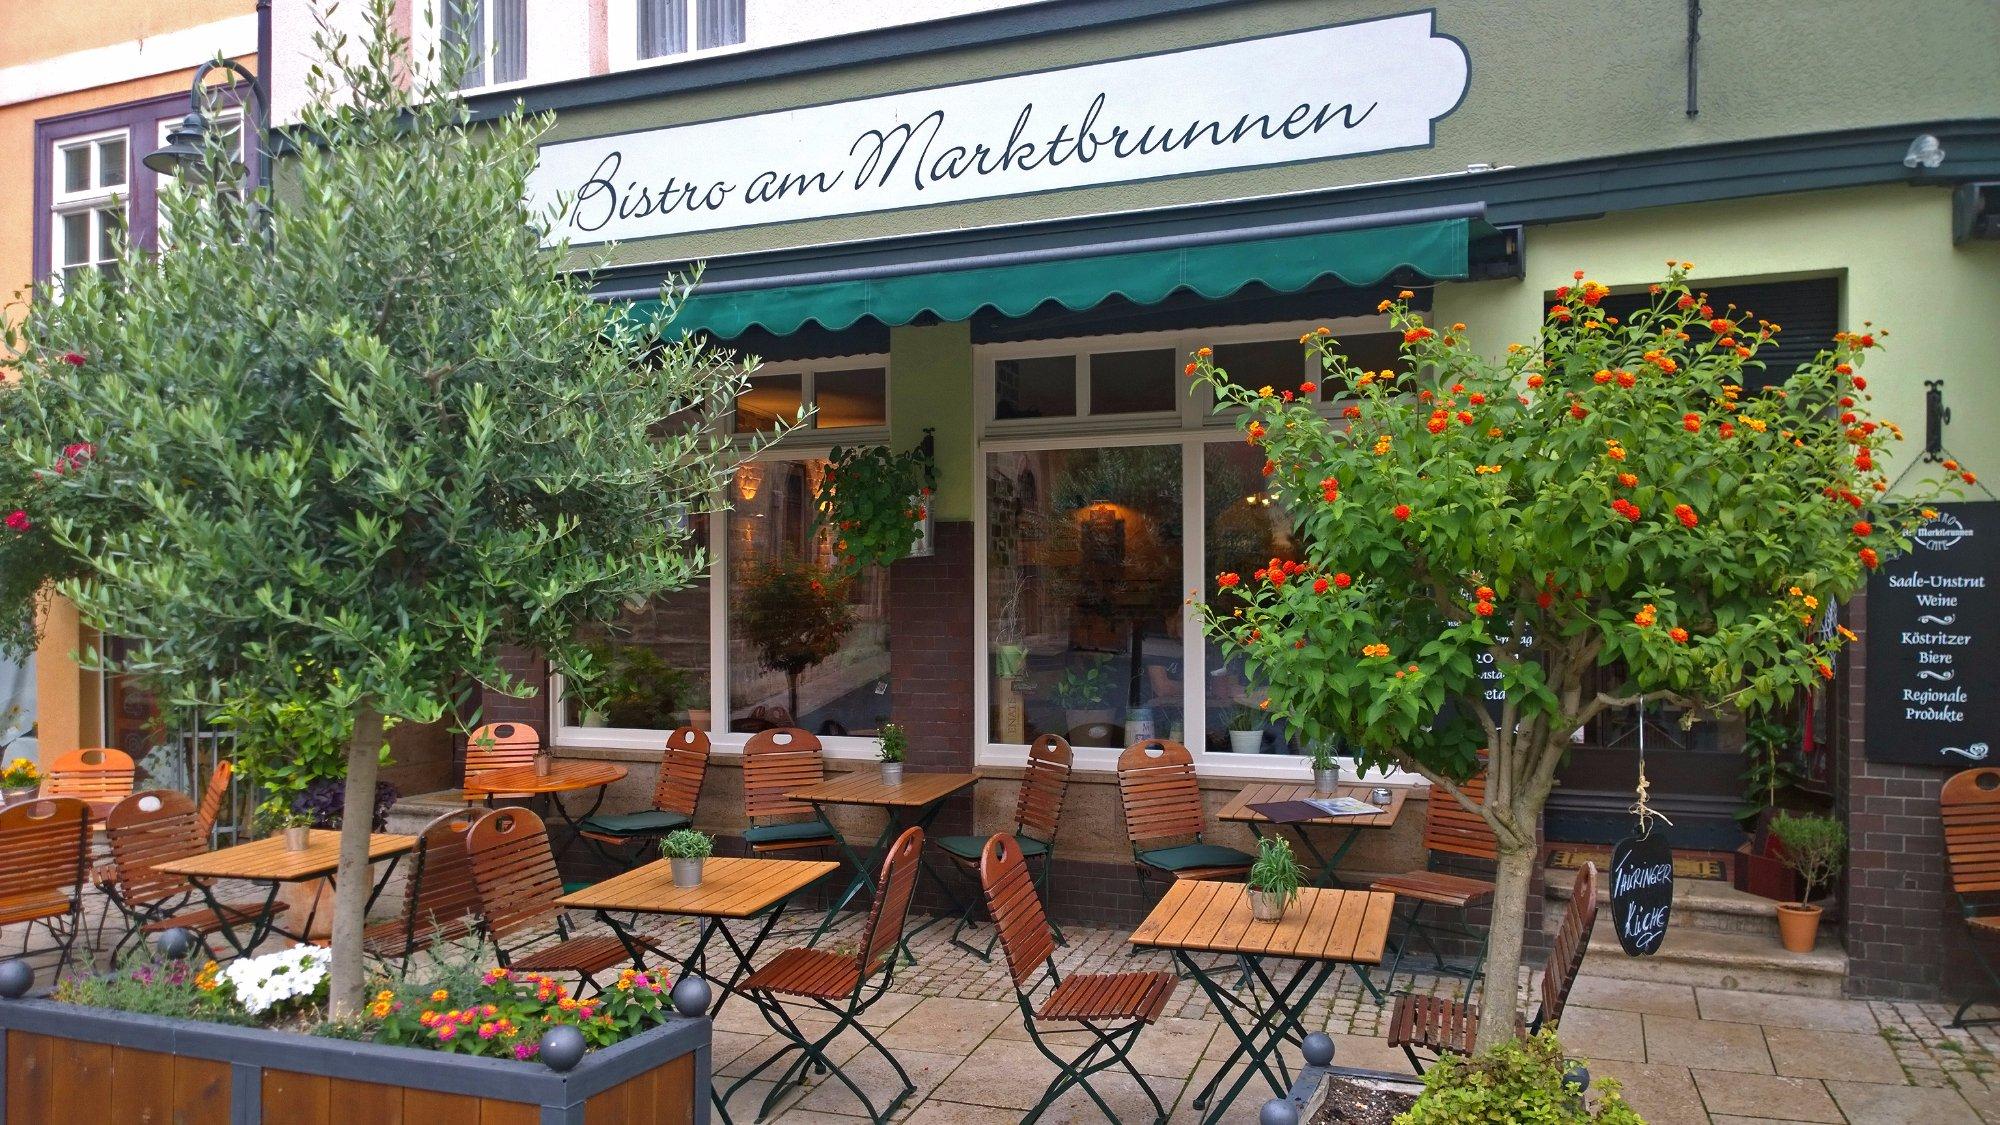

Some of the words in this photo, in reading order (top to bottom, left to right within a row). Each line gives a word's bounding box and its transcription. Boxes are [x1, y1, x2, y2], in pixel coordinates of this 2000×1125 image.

[569, 152, 736, 231] Bistro
[745, 171, 844, 204] am
[850, 93, 1378, 190] Marktbrunnen
[1889, 570, 1986, 588] Saale-Unstrut
[1916, 593, 1958, 607] Weine
[1901, 631, 1971, 646] Köstritzer
[1918, 650, 1953, 664] Biere
[1903, 686, 1968, 704] Regionale
[1905, 704, 1964, 722] Produkte
